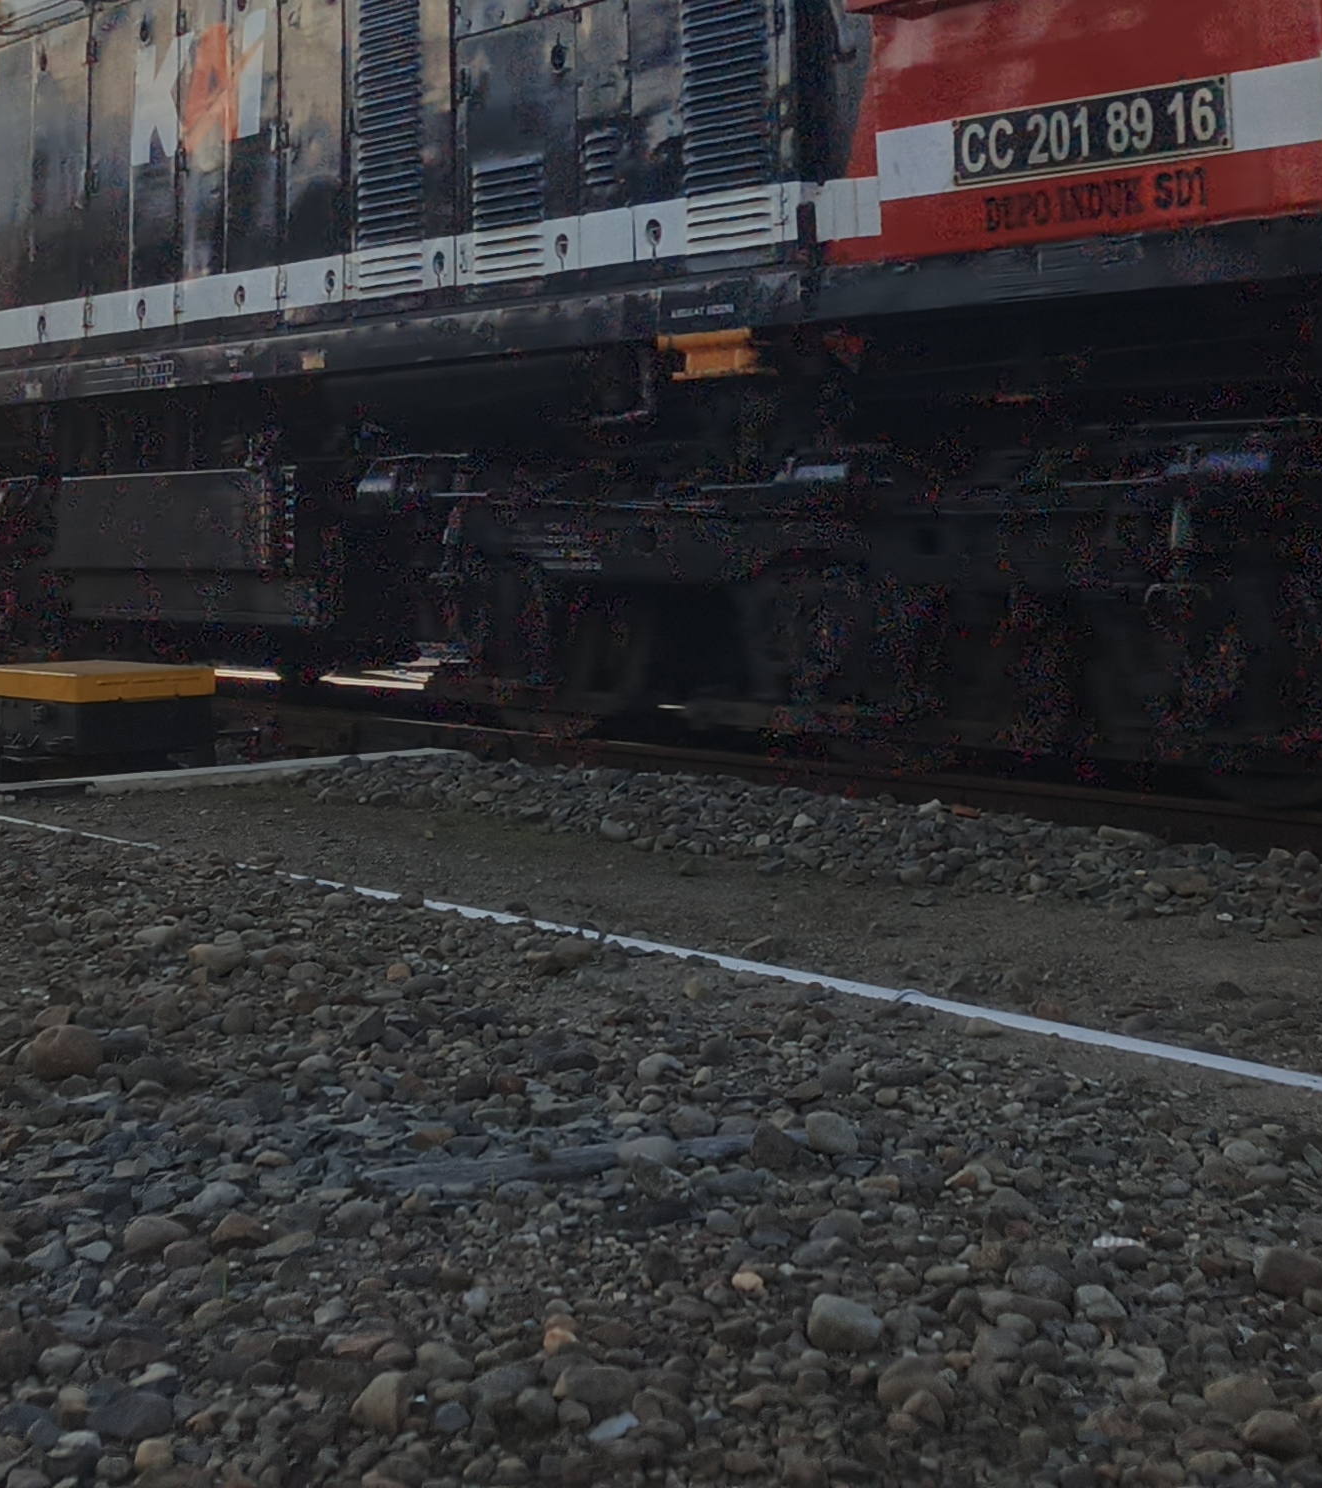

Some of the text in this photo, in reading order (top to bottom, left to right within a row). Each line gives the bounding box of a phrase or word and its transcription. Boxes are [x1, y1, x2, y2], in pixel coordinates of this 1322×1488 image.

[131, 8, 266, 166] KAI
[962, 87, 1217, 173] CC 201 89 16
[984, 190, 1051, 232] DEPO
